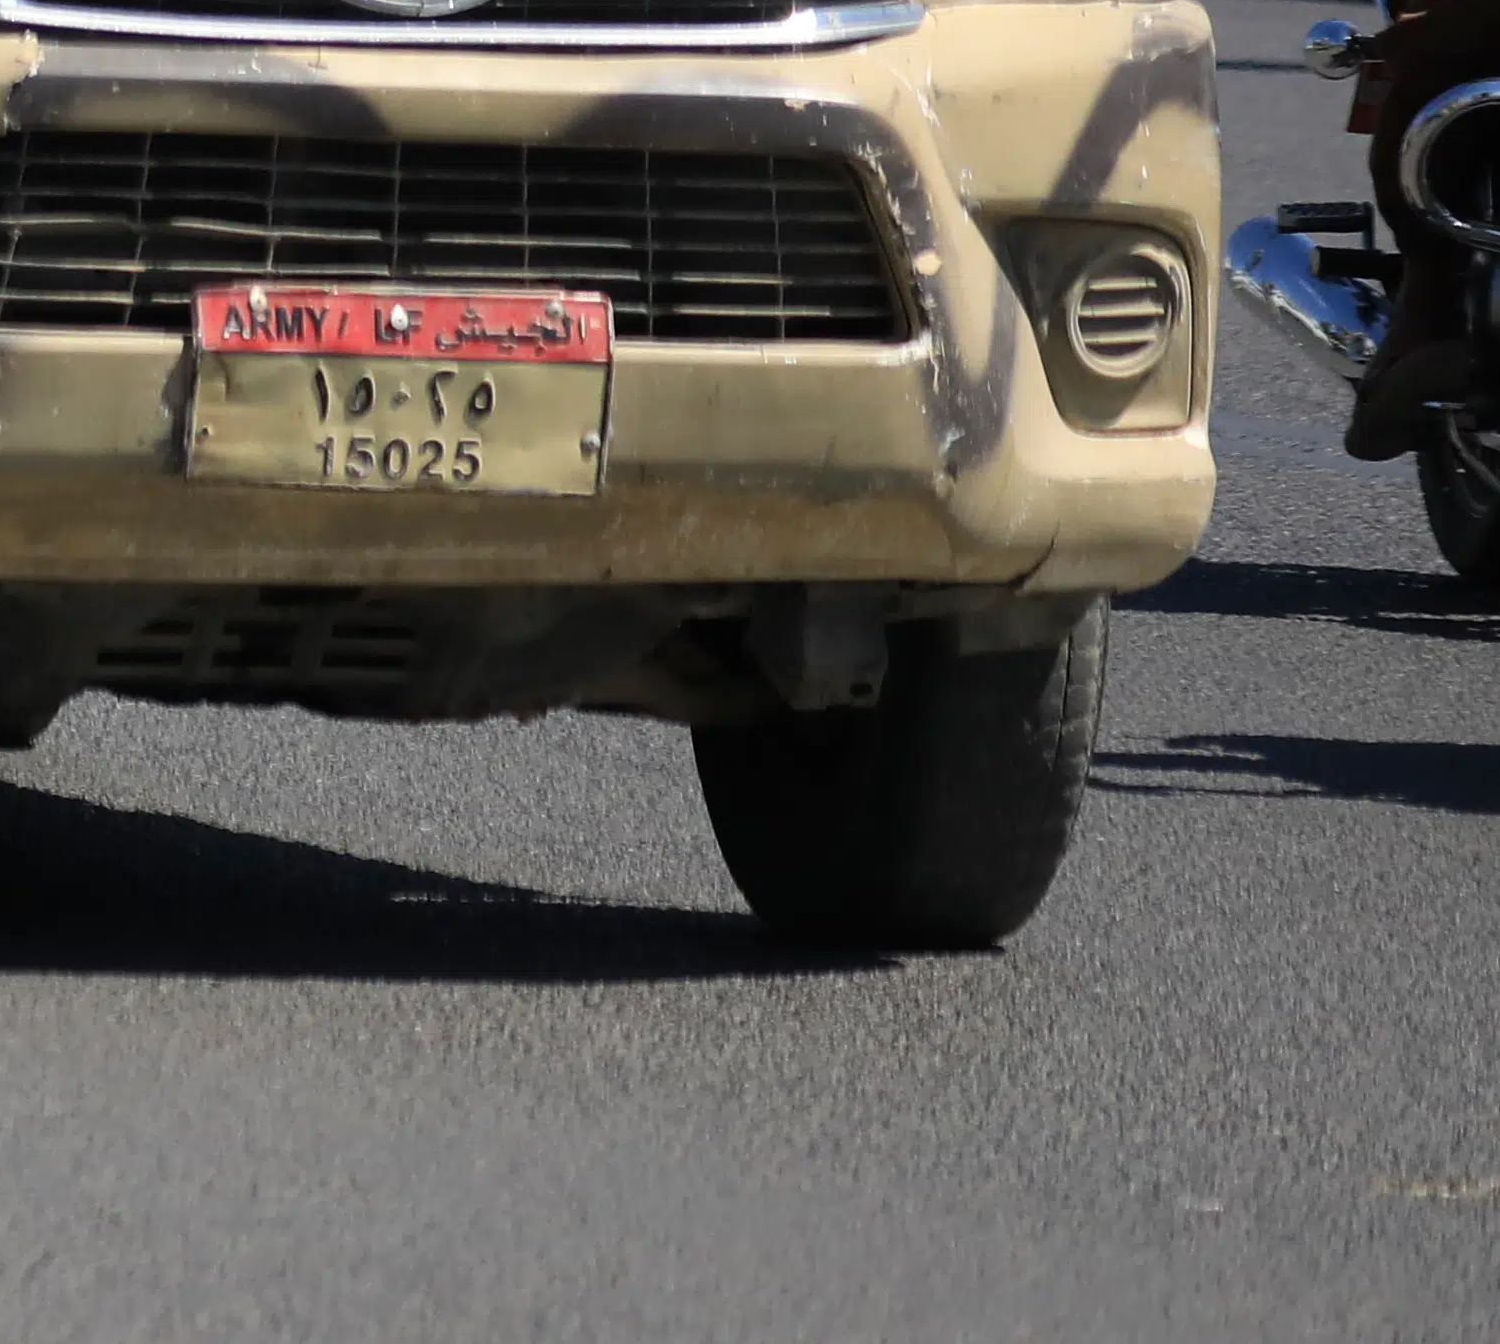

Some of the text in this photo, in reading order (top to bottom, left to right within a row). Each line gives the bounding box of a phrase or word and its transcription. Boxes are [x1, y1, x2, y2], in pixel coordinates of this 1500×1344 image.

[435, 303, 588, 355] الجيش
[313, 359, 496, 423] ١٥٠٢٥
[316, 433, 484, 483] 15025
